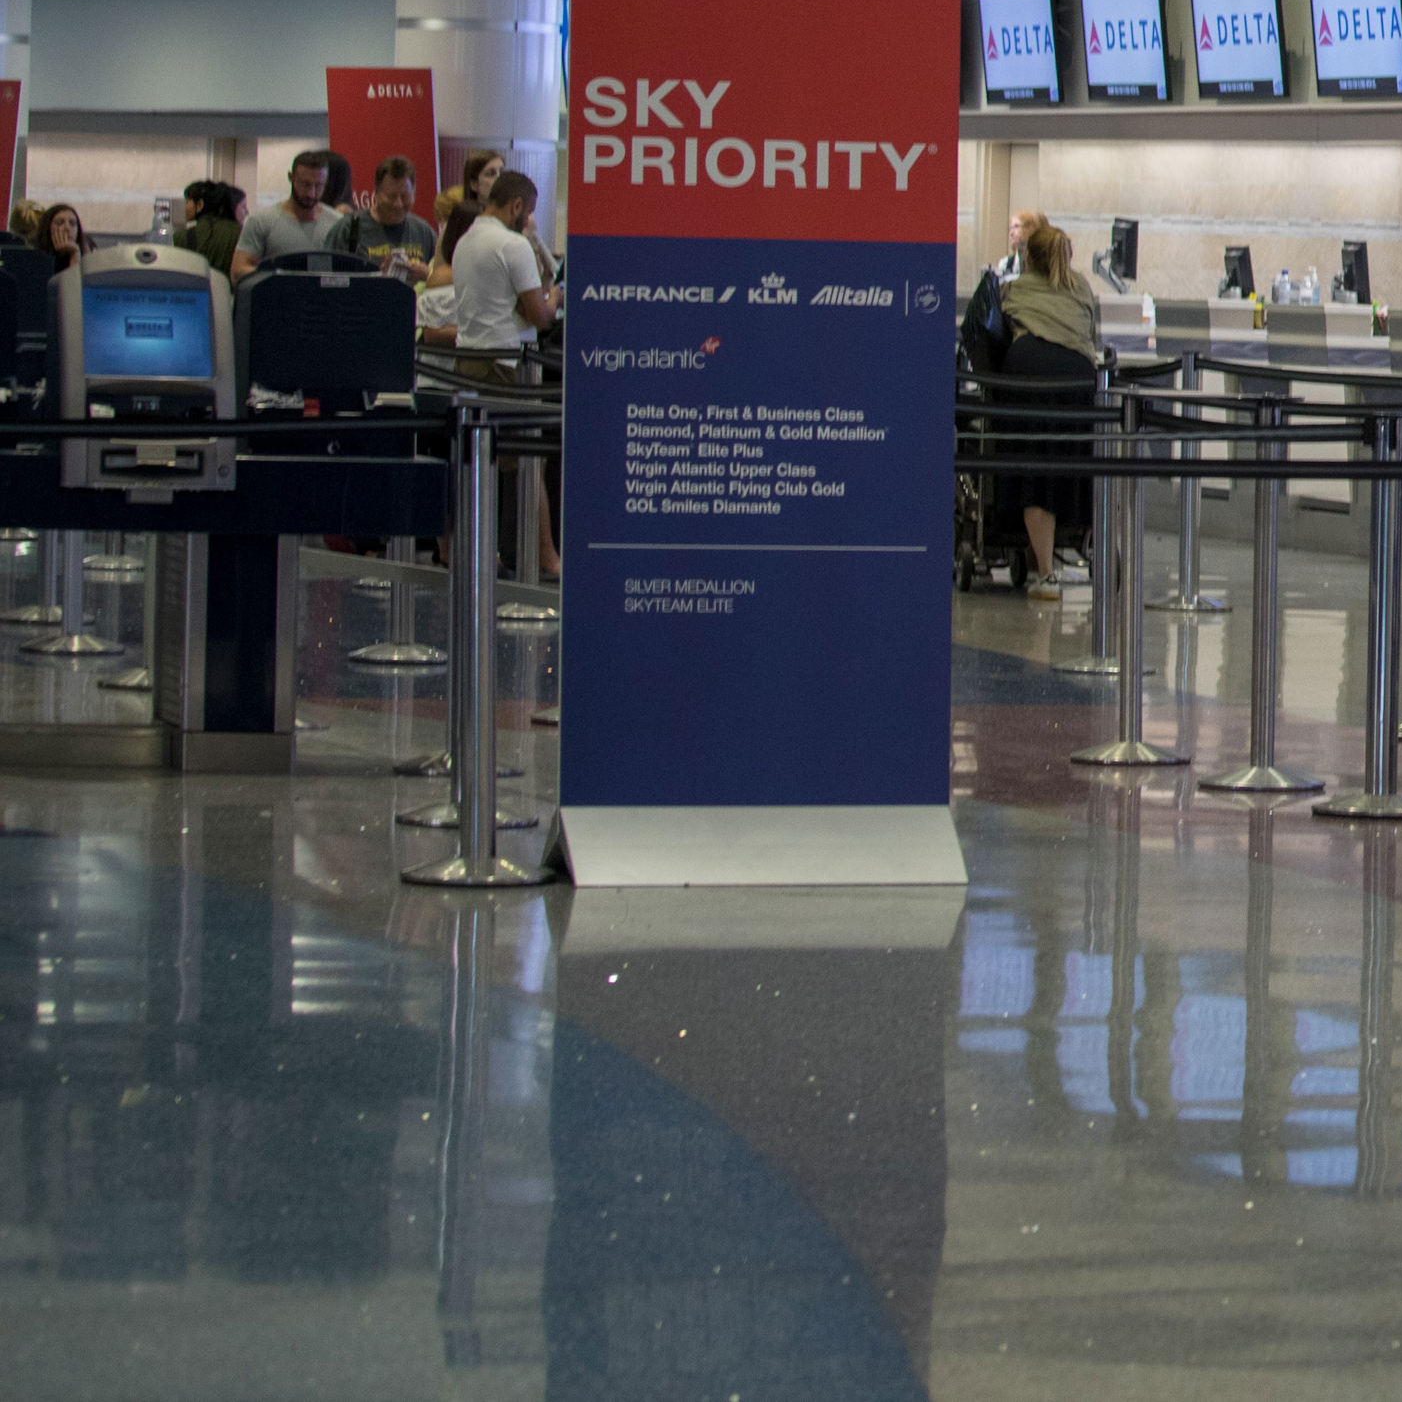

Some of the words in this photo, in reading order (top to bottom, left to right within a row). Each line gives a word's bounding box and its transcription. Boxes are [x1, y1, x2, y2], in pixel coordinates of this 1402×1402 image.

[1216, 12, 1278, 46] DELTA
[1337, 6, 1401, 41] DELTA
[1001, 24, 1053, 57] DELTA
[1105, 19, 1161, 51] DELTA
[378, 83, 413, 98] DELTA
[583, 76, 731, 129] SKY
[582, 284, 714, 303] AIRFRANCE
[748, 288, 797, 305] KLM
[810, 285, 893, 307] Alitalia
[581, 346, 635, 372] virgin
[638, 347, 705, 370] atlantic
[626, 403, 664, 420] Delta
[668, 404, 703, 422] One,
[707, 405, 739, 420] First
[742, 406, 752, 421] &
[757, 406, 821, 422] Business
[825, 407, 864, 422] Class
[626, 423, 695, 440] Diamond,
[699, 424, 761, 439] Platinum
[765, 425, 775, 440] &
[780, 425, 813, 440] Gold
[817, 425, 885, 441] Medallion
[626, 441, 690, 459] SkyTeam
[698, 442, 729, 458] Elite
[733, 443, 764, 458] Plus
[625, 460, 667, 478] Virgin
[671, 461, 725, 476] Atlantic
[729, 462, 773, 479] Upper
[777, 462, 816, 477] Class
[625, 479, 667, 496] Virgin
[671, 480, 725, 495] Atlantic
[729, 480, 771, 498] Flying
[775, 481, 807, 496] Club
[811, 482, 845, 496] Gold
[625, 497, 658, 513] GOL
[662, 498, 709, 513] Smiles
[713, 499, 781, 515] Diamante
[624, 578, 671, 594] SILVER
[675, 578, 755, 595] MEDALLION
[624, 597, 693, 613] SKYTEAM
[697, 598, 733, 613] ELITE
